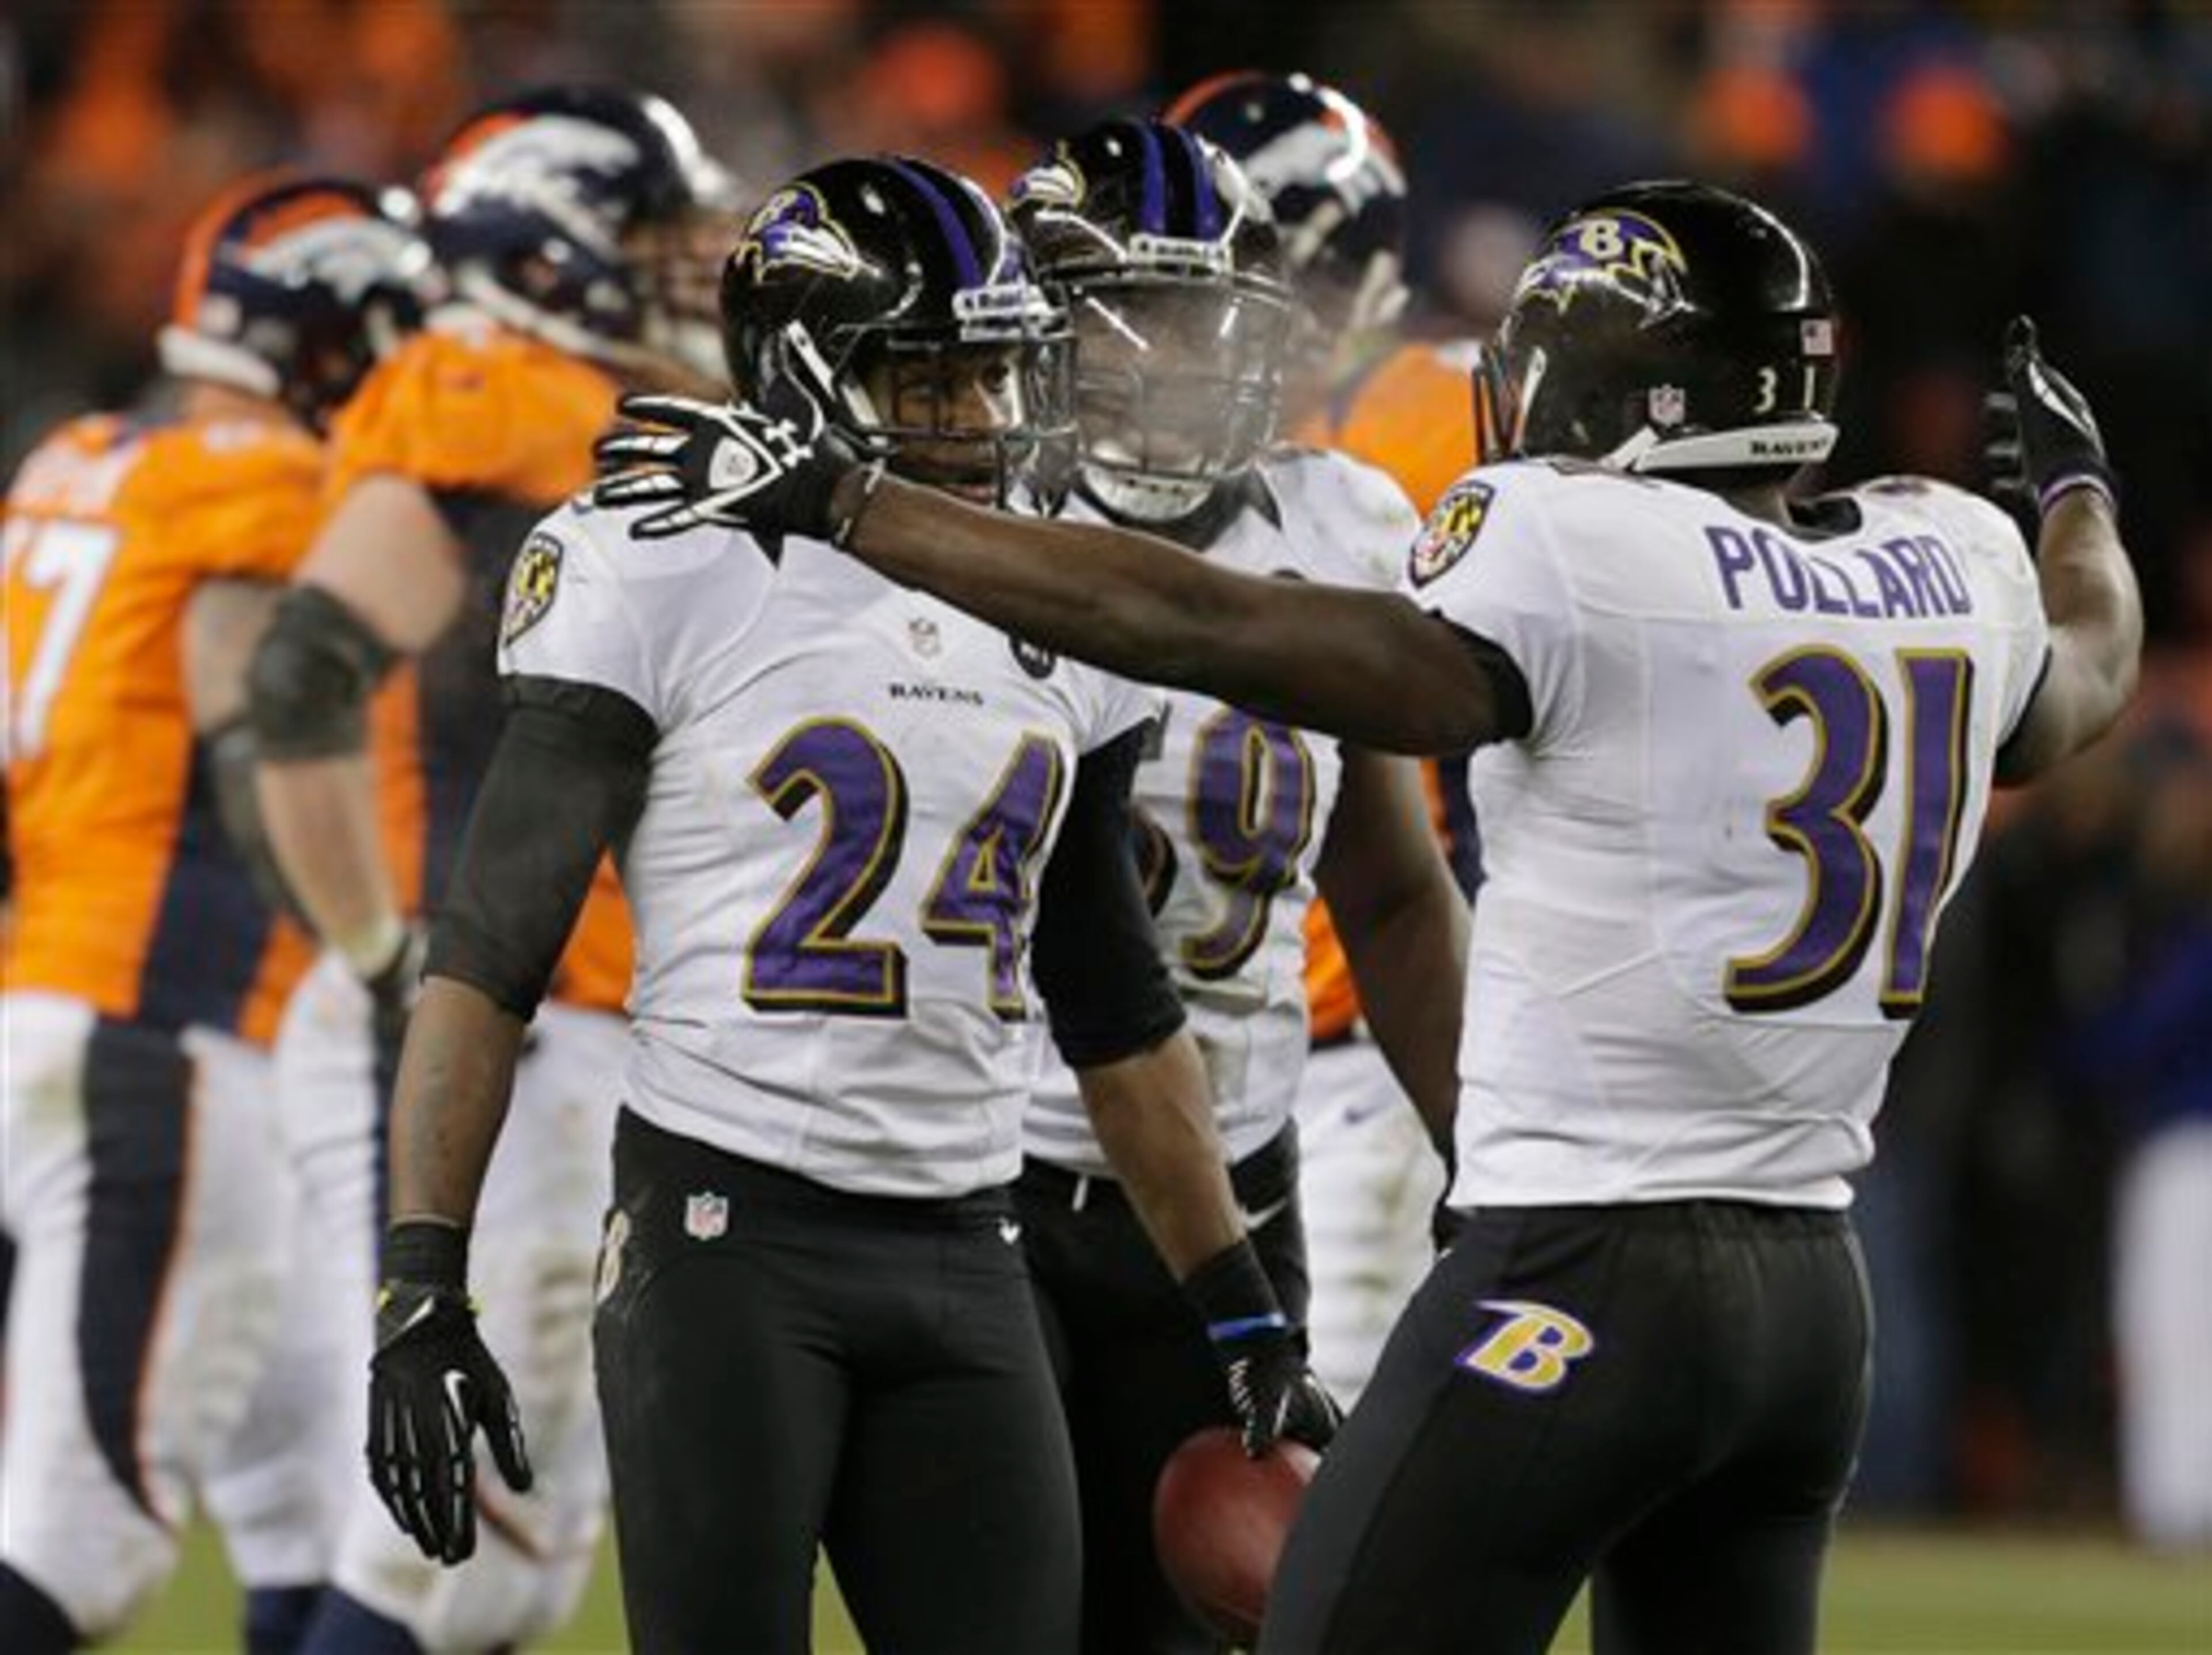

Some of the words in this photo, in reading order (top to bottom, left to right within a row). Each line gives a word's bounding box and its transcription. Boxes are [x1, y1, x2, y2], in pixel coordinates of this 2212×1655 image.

[0, 514, 116, 763] 7
[889, 682, 984, 706] RAVENS
[1705, 525, 1974, 619] POLLARD
[741, 715, 1066, 1021] 24
[1130, 704, 1317, 981] 9
[1724, 643, 1976, 1020] 31
